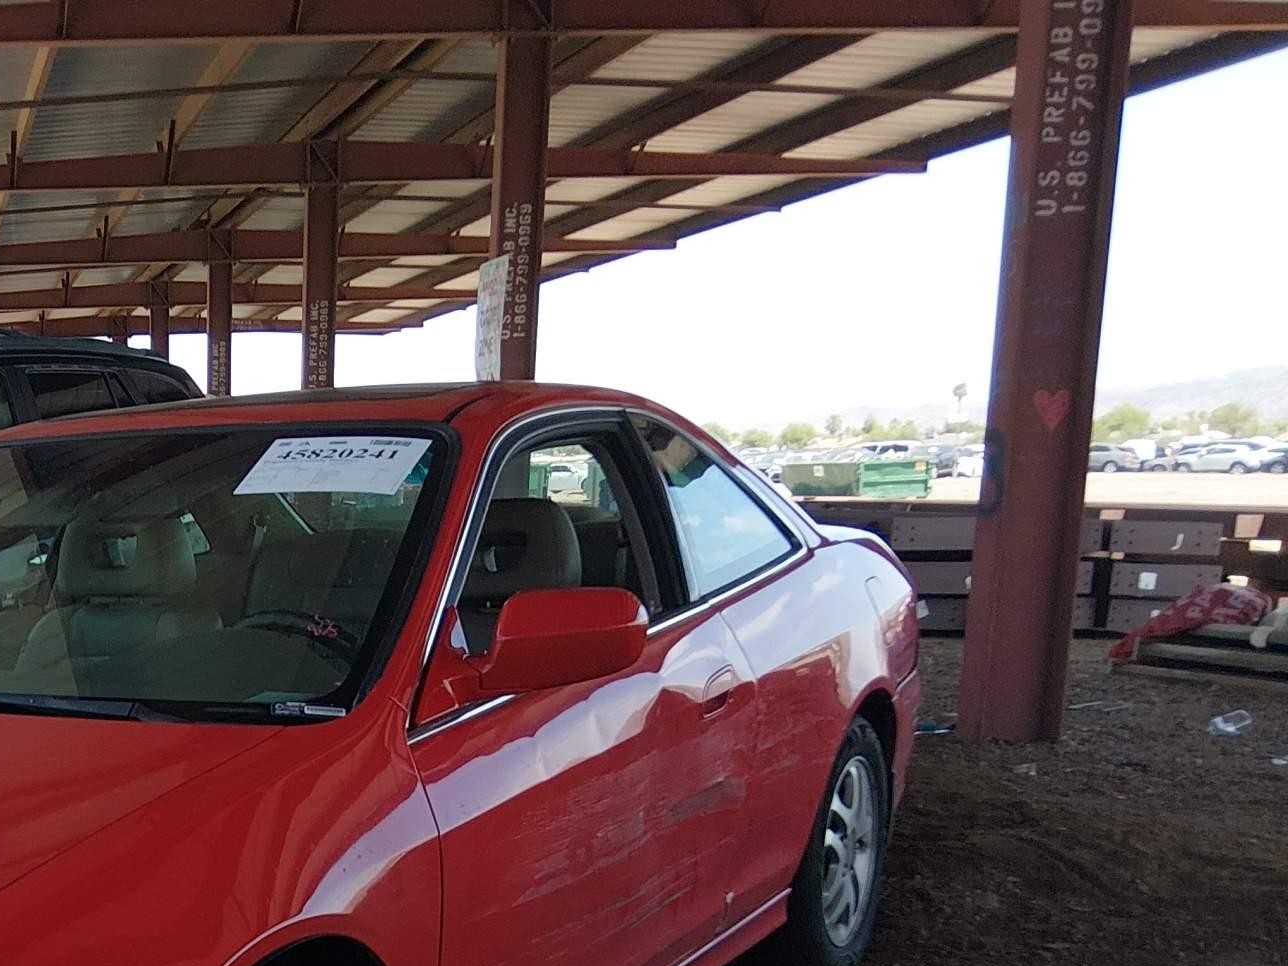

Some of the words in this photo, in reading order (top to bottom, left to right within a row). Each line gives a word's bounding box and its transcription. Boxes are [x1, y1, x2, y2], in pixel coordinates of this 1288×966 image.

[1041, 25, 1074, 143] PREFAB
[1034, 161, 1062, 217] U.S.
[504, 202, 518, 233] INC.
[513, 203, 533, 338] 1-866-799-0969
[309, 325, 319, 366] PREFAB
[277, 448, 399, 460] 45820241
